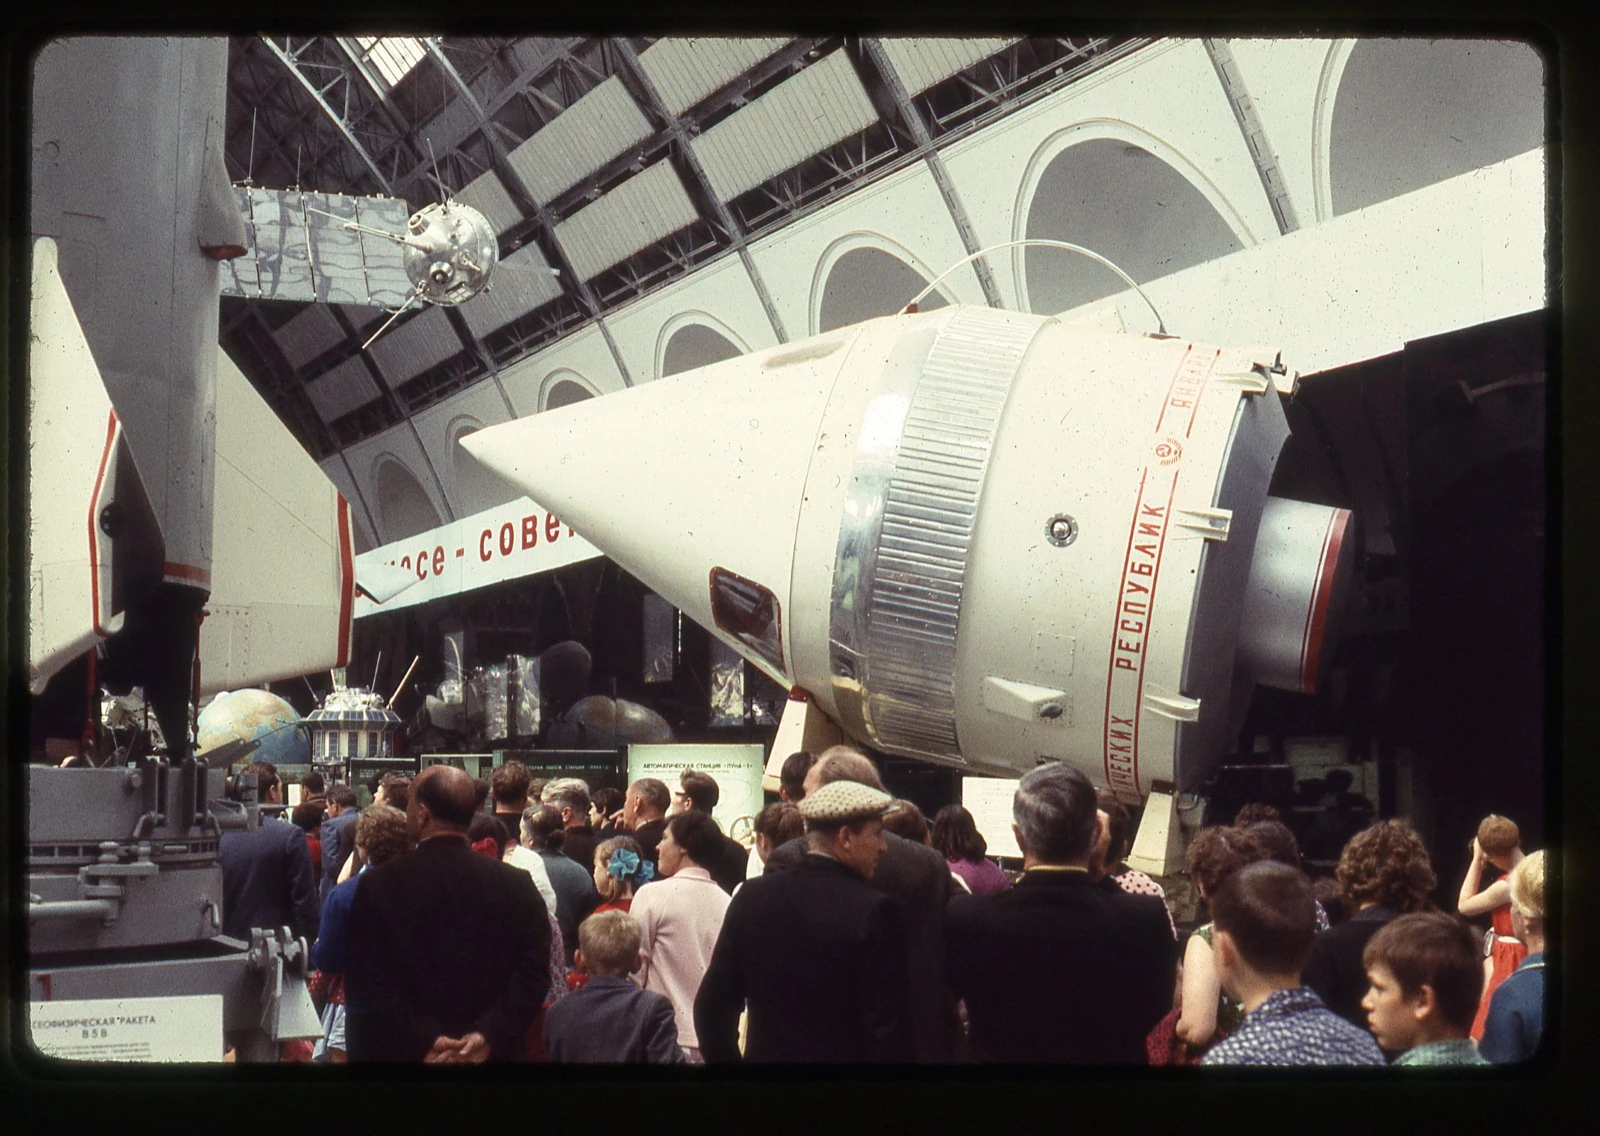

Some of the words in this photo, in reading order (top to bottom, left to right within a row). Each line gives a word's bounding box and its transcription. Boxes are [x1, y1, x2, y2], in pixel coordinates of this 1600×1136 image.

[479, 512, 575, 562] сове
[1115, 503, 1165, 671] РЕСПУБЛИК
[32, 1017, 116, 1029] ГЕОФИЗИЧЕСКАЯ
[119, 1015, 156, 1026] РАКЕТА
